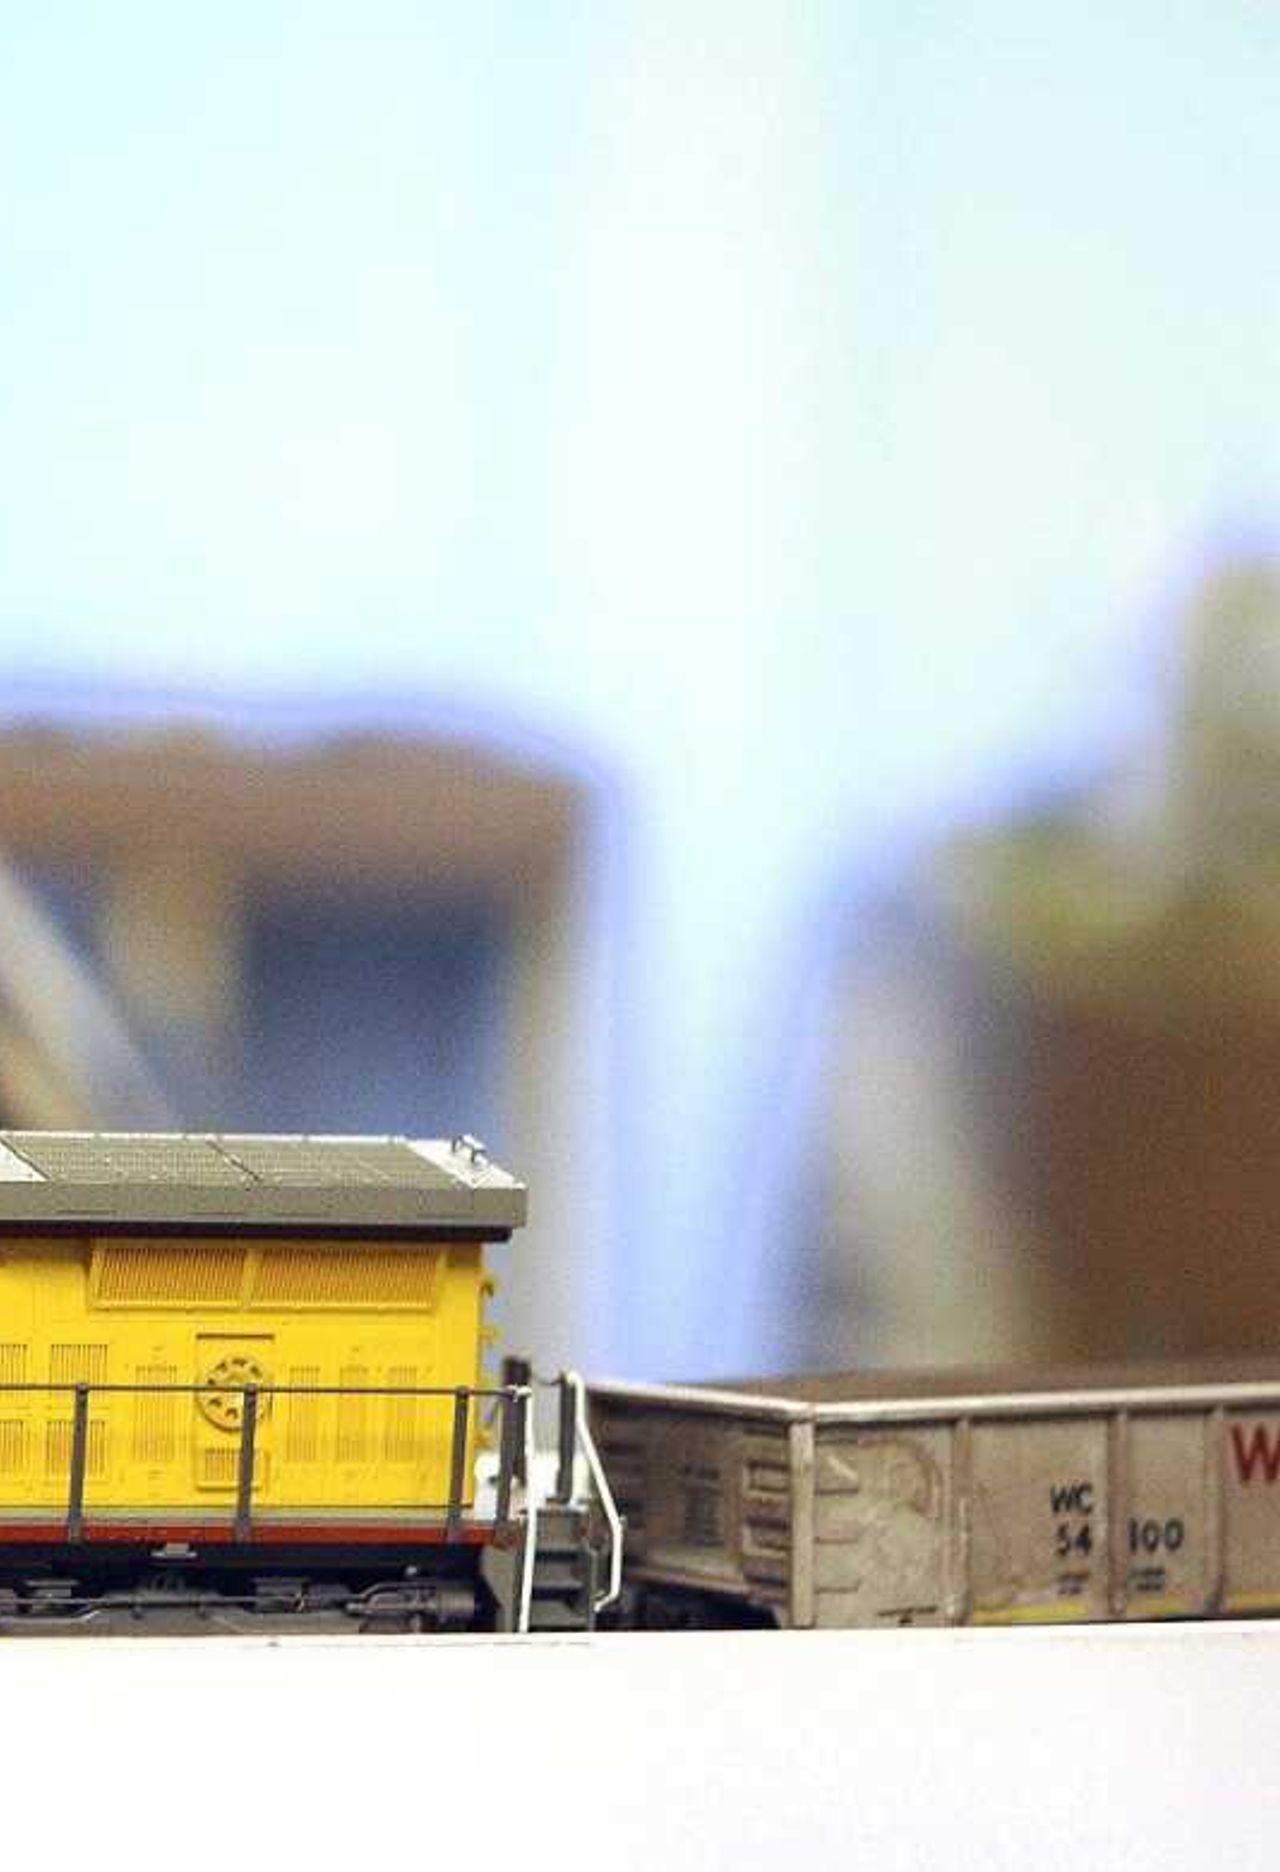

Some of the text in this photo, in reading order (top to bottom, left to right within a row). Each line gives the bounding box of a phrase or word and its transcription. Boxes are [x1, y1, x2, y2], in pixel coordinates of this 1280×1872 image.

[1050, 1482, 1093, 1514] WC
[1055, 1518, 1184, 1556] 54 100
